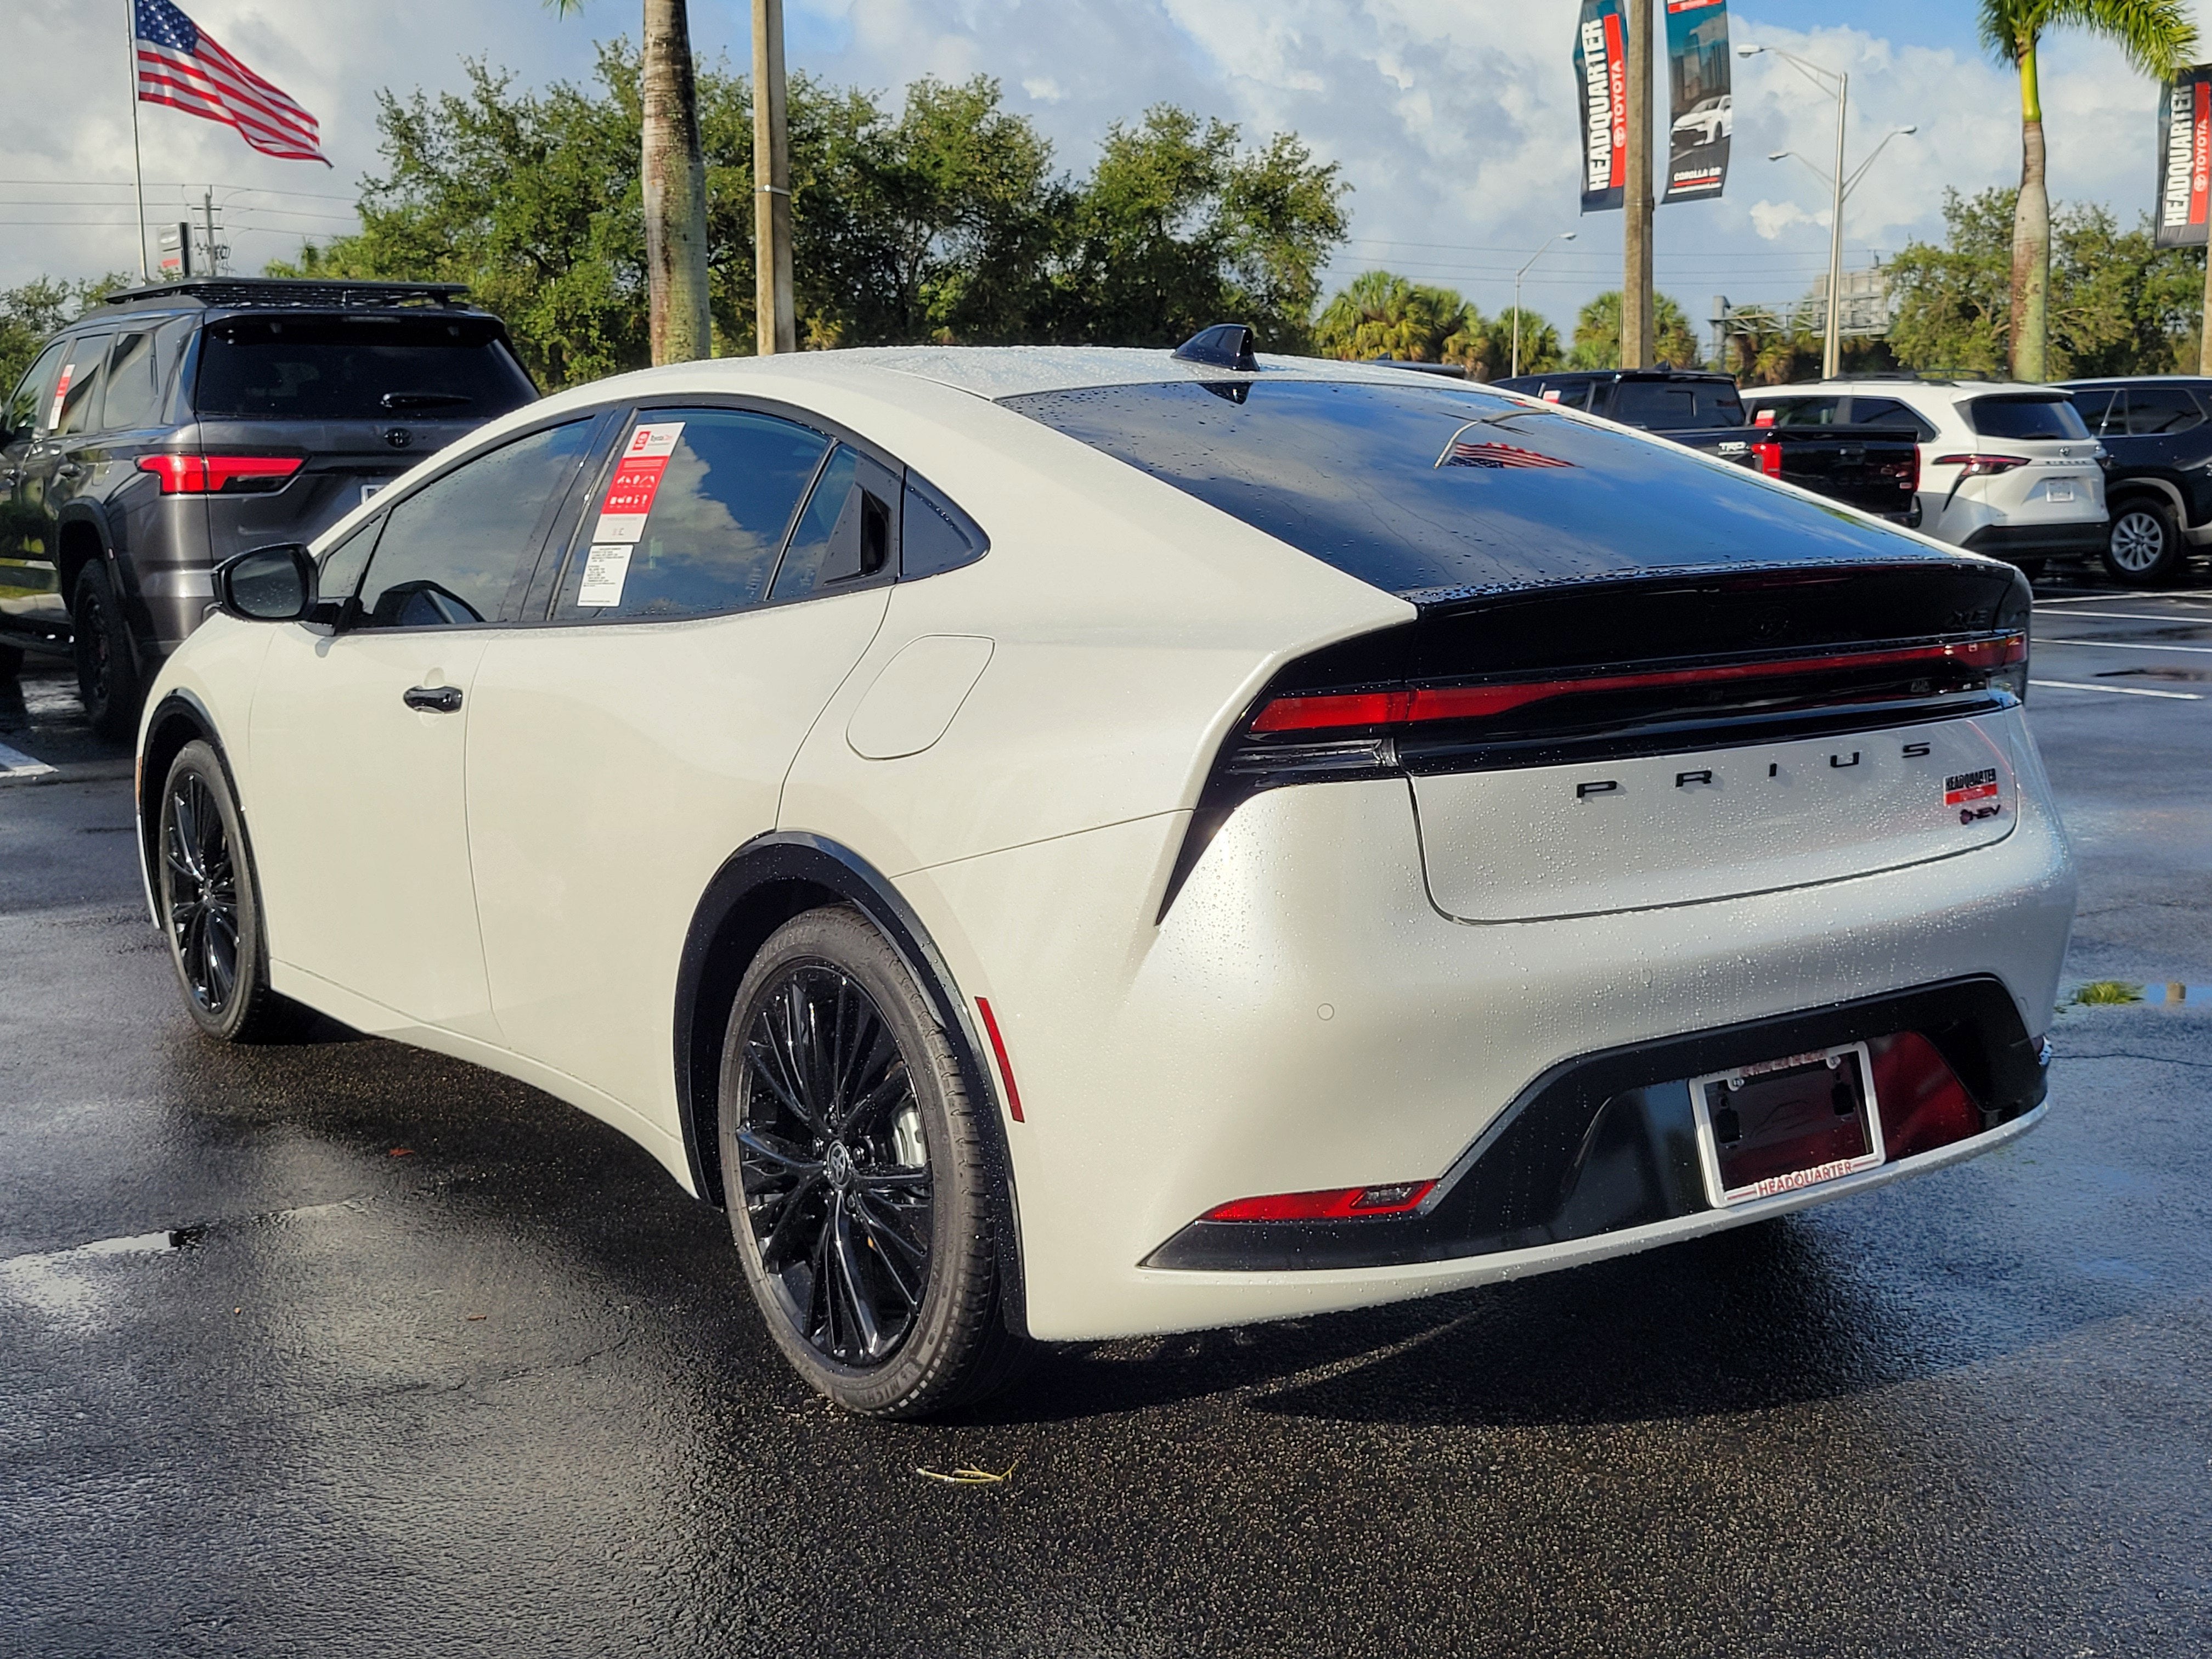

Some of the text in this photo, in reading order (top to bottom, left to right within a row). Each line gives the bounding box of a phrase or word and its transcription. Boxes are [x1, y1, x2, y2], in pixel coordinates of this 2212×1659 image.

[1581, 19, 1612, 191] HEADQUARTER
[1611, 60, 1626, 125] TOYOTA
[2164, 84, 2194, 227] HEADQUARTER
[2195, 119, 2208, 173] TOYOTA
[1576, 741, 1931, 798] PRIUS
[1945, 768, 1996, 791] HEADQUARTER
[1757, 1160, 1853, 1197] HEADQUARTER
